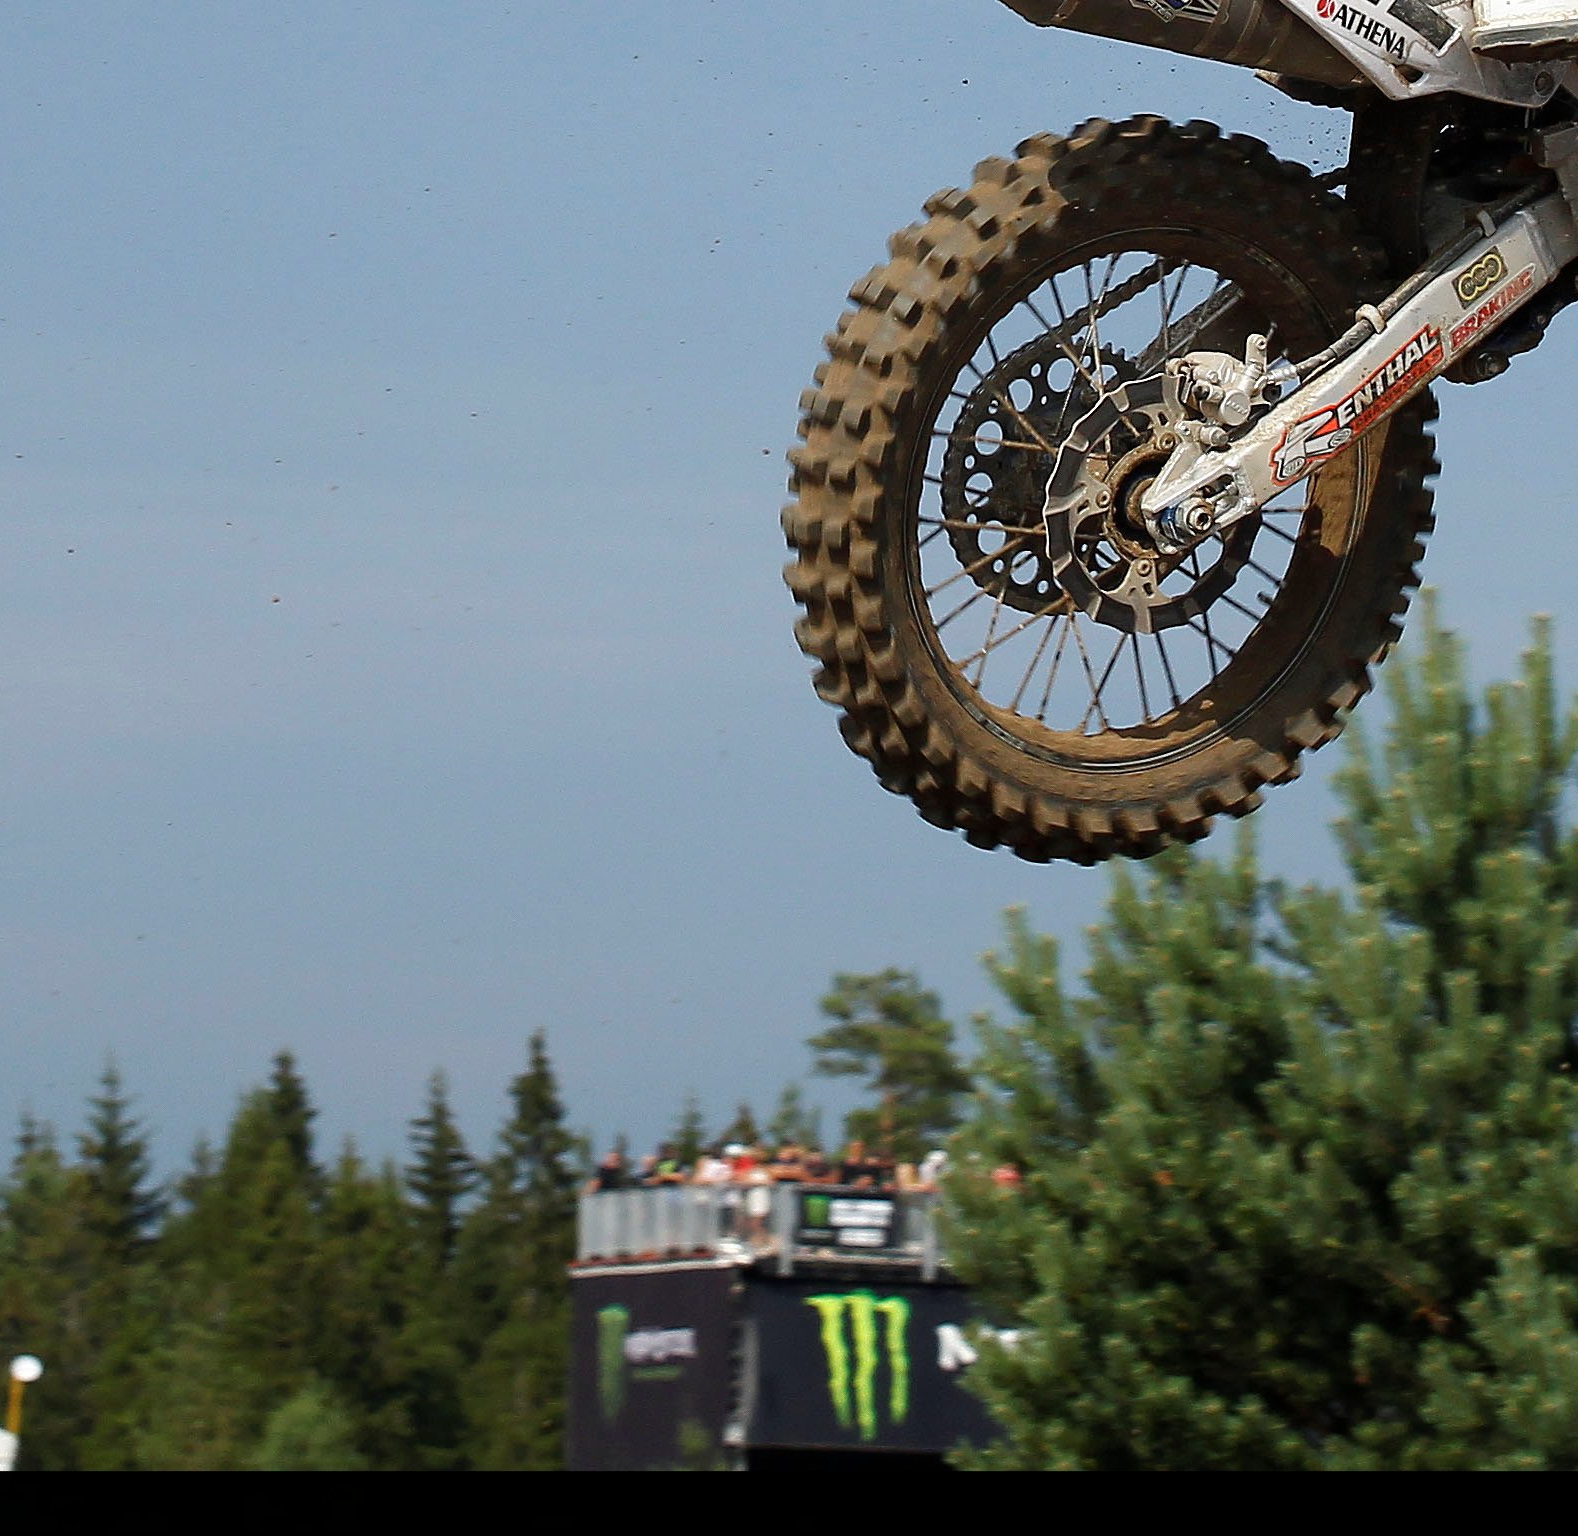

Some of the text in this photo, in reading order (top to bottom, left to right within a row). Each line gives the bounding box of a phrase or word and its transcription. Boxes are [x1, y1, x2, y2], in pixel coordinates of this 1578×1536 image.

[1332, 3, 1407, 60] ATHENA
[1450, 267, 1534, 351] BRAKING
[1274, 331, 1441, 480] RENTHAL
